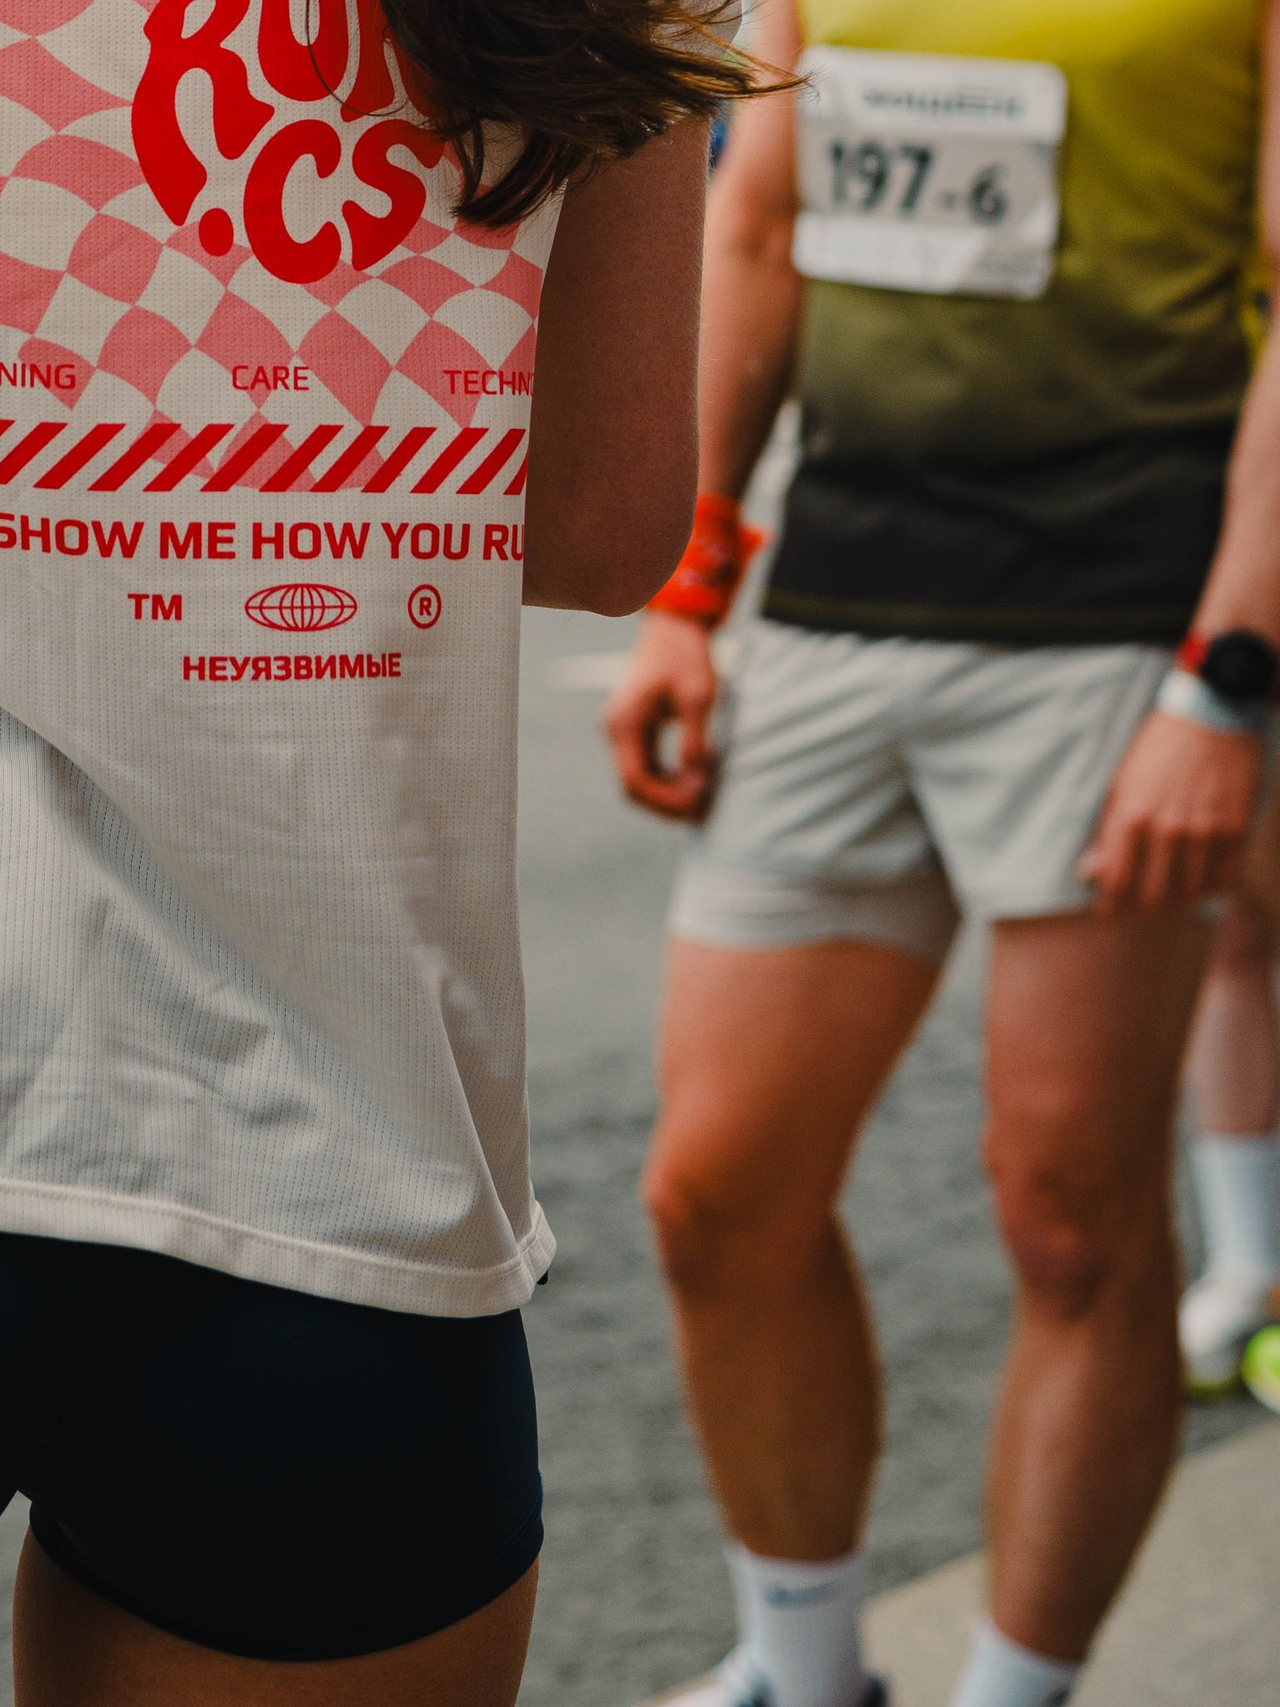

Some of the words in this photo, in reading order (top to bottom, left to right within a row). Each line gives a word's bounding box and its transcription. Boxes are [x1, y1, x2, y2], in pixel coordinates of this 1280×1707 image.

[231, 364, 310, 392] CARE
[442, 369, 534, 396] TECHN
[159, 521, 236, 560] ME
[251, 522, 371, 560] HOW
[381, 522, 471, 561] YOU
[127, 593, 183, 621] TM
[182, 652, 402, 682] НЕУЯЗВИМЫЕ
